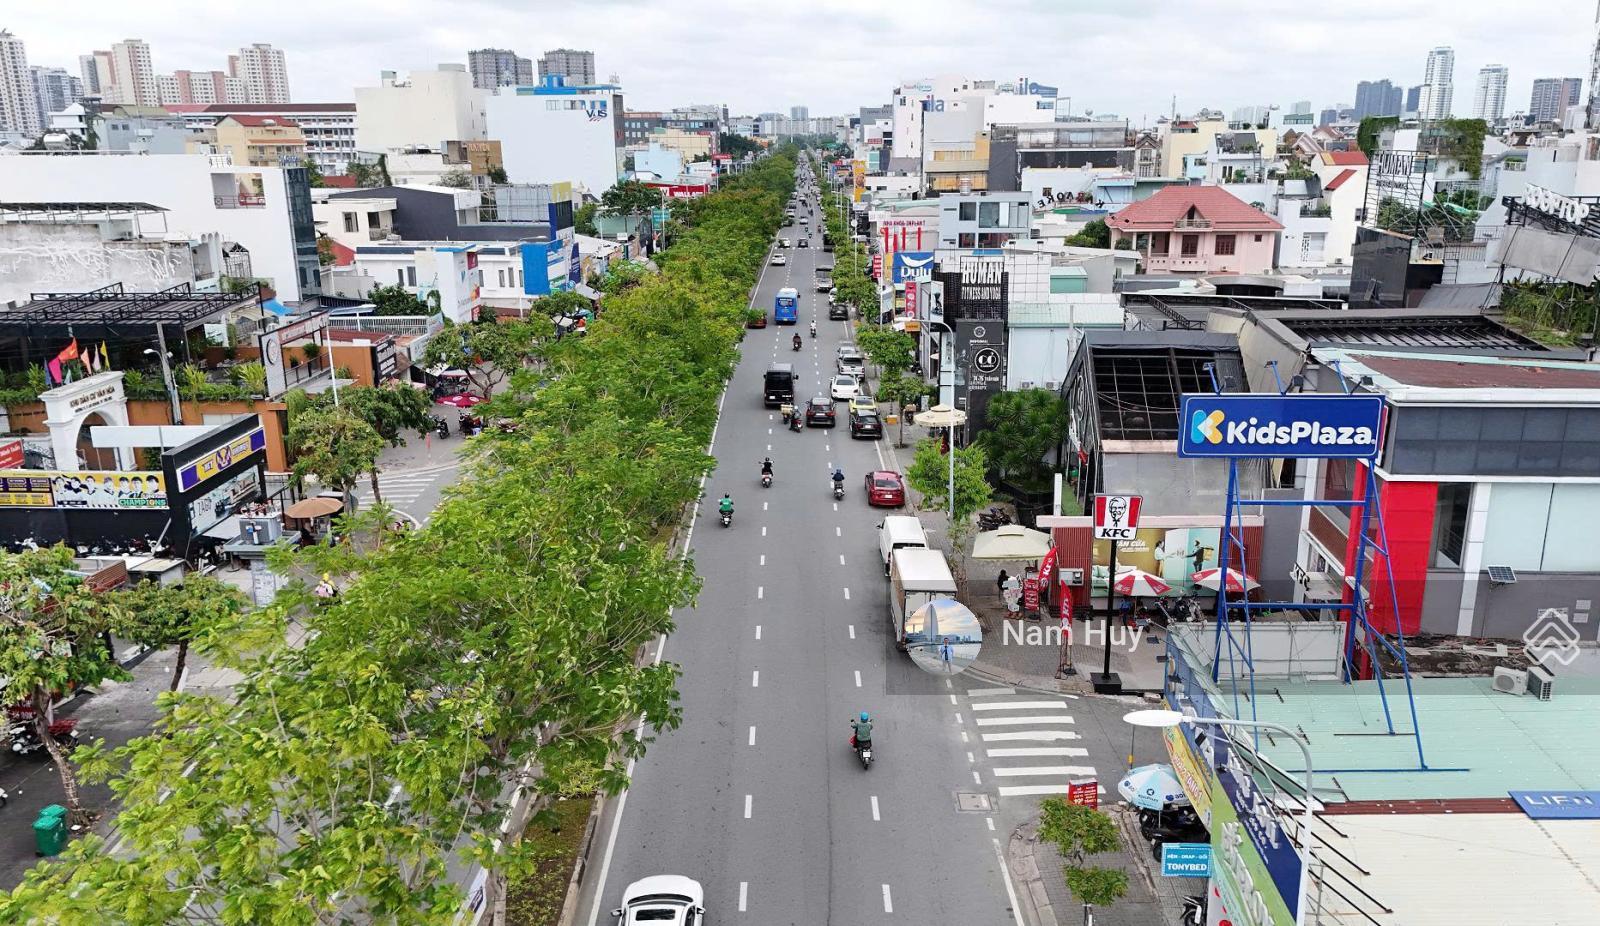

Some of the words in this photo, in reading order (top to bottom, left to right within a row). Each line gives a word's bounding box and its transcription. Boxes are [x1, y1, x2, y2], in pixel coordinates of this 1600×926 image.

[961, 262, 1003, 284] HUMAN
[1101, 528, 1130, 538] KFC
[1167, 863, 1208, 871] TONYBED
